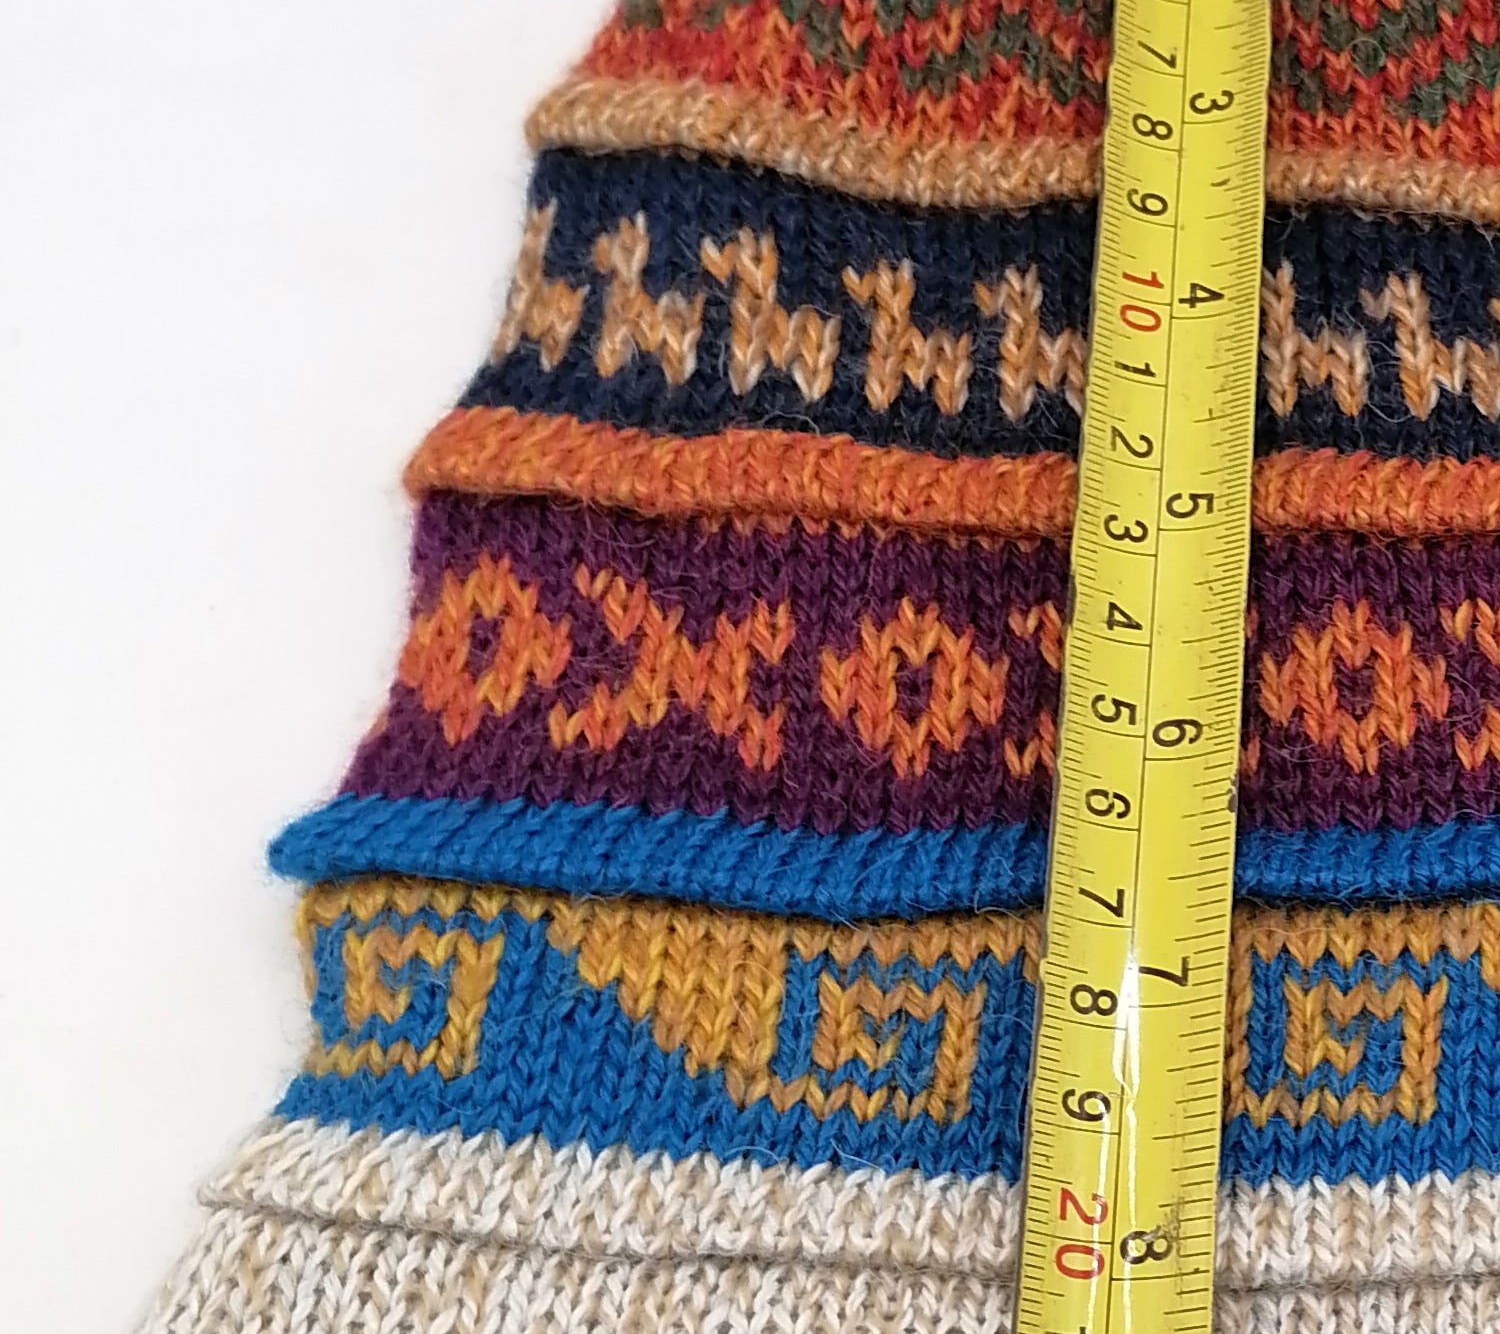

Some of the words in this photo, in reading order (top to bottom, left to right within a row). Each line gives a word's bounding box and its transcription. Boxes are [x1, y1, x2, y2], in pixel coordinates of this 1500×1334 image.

[1137, 40, 1177, 69] 7
[1189, 90, 1234, 115] 3
[1132, 113, 1173, 141] 8
[1126, 188, 1168, 217] 9
[1119, 271, 1164, 333] 10
[1178, 282, 1225, 309] 4
[1114, 360, 1157, 378] 1
[1110, 425, 1154, 459] 2
[1166, 492, 1214, 519] 5
[1103, 514, 1148, 544] 3
[1105, 602, 1143, 631] 4
[1091, 694, 1137, 726] 5
[1152, 718, 1203, 748] 6
[1085, 788, 1131, 820] 6
[1078, 888, 1125, 918] 7
[1139, 956, 1190, 987] 7
[1069, 984, 1118, 1017] 8
[1061, 1088, 1111, 1123] 9
[1055, 1187, 1108, 1280] 20
[1120, 1230, 1172, 1265] 8
